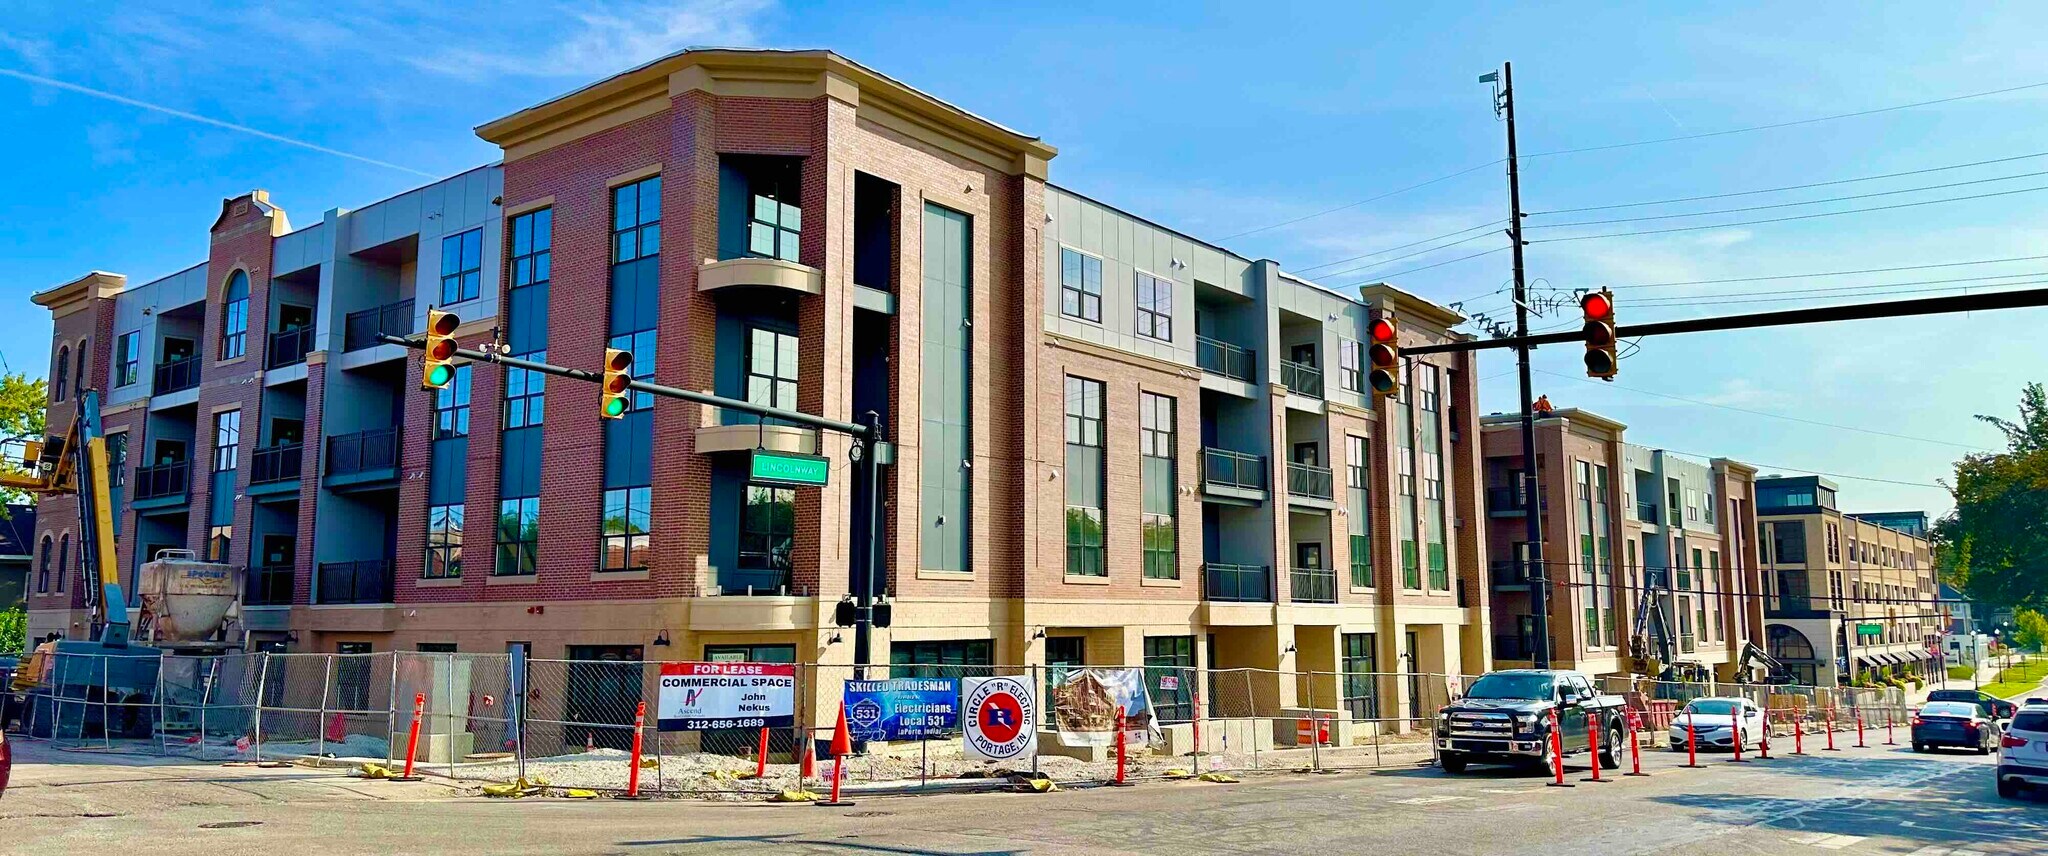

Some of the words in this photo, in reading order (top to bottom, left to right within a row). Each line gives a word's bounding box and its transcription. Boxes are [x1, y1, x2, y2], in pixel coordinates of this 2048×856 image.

[761, 462, 819, 475] LINCOLNWAY
[693, 665, 719, 674] FOR
[723, 665, 763, 675] LEASE
[662, 678, 747, 687] COMMERCIAL
[751, 678, 792, 687] SPACE
[849, 681, 889, 692] SKILLED
[892, 680, 951, 691] TRADESMAN
[741, 693, 766, 701] John
[738, 704, 771, 712] Nekus
[894, 702, 952, 713] Electricians
[968, 686, 991, 728] CIRCLE
[1009, 684, 1031, 725] ELECTRIC
[856, 709, 876, 719] 531
[687, 718, 765, 729] 312-656-1689
[900, 715, 925, 726] Local
[927, 715, 945, 726] 531
[975, 734, 1020, 755] PORTAGE,
[1017, 732, 1027, 745] IN
